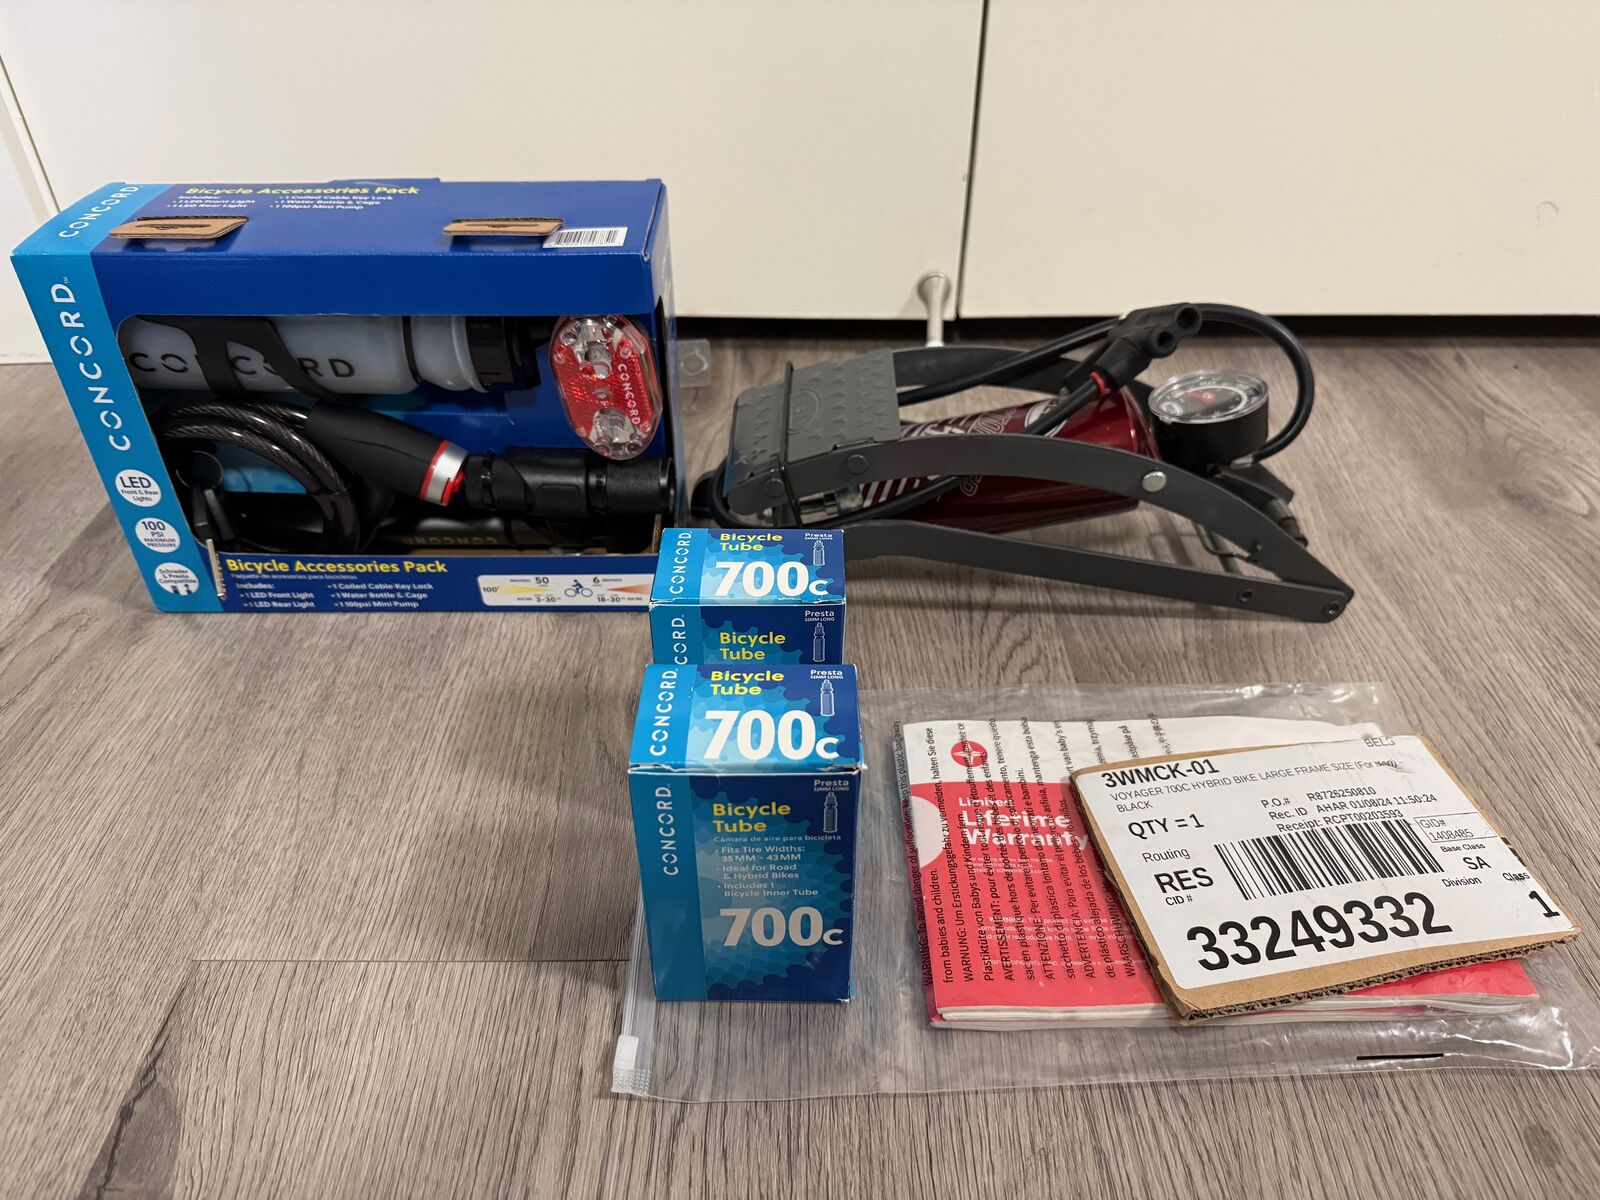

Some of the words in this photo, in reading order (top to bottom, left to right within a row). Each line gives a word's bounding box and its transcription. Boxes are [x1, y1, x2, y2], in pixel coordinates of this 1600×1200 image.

[375, 186, 420, 194] Pack
[58, 185, 140, 238] CONCORD
[51, 283, 132, 452] CONCORD
[128, 352, 355, 380] COCRD
[618, 363, 640, 426] CONCORD
[120, 476, 151, 488] LED
[142, 521, 166, 531] 100
[720, 533, 783, 543] Bicycle
[720, 543, 764, 551] Tube
[226, 559, 290, 574] Bicycle
[294, 560, 400, 572] Accessories
[403, 560, 448, 572] Pack
[670, 532, 692, 595] CONCORD
[535, 576, 549, 584] 50
[593, 576, 600, 584] 6
[292, 592, 314, 600] Light
[405, 592, 428, 600] Cage
[672, 615, 689, 665] CORD
[720, 632, 786, 647] Bicycle
[720, 648, 765, 660] Tube
[711, 671, 784, 683] Bicycle
[710, 684, 762, 696] Tube
[650, 670, 678, 756] CONCORD
[925, 727, 935, 744] diese
[989, 718, 1002, 740] questo
[1025, 735, 1034, 750] esta
[1055, 730, 1067, 752] baby's
[896, 752, 908, 774] plastic
[994, 741, 1005, 764] tenere
[930, 757, 940, 779] halten
[979, 752, 992, 778] enfants
[1030, 750, 1044, 786] mantenga
[1101, 758, 1219, 788] 3WMCK-01
[814, 779, 850, 787] Presta
[1015, 768, 1030, 800] bambini.
[1110, 786, 1162, 801] VOYAGER
[1164, 784, 1190, 794] 700C
[1192, 778, 1232, 790] HYBRID
[1234, 774, 1258, 784] BIKE
[1260, 769, 1294, 780] LARGE
[1295, 764, 1331, 775] FRAME
[1331, 762, 1354, 771] SIZE
[1355, 760, 1374, 770] (For
[934, 780, 947, 822] vermeiden,
[1039, 787, 1051, 813] asfixia,
[1116, 800, 1153, 813] BLACK
[1261, 797, 1290, 808] P.O.#
[1307, 786, 1376, 802] R8726250810
[1269, 809, 1294, 820] Rec.
[1298, 807, 1308, 816] ID
[1316, 802, 1348, 814] AHAR
[1350, 799, 1392, 810] 01/08/24
[1393, 794, 1437, 805] 11:50:24
[712, 802, 791, 819] Bicycle
[962, 811, 1069, 828] Lifetime
[1276, 820, 1322, 833] Receipt:
[1323, 809, 1403, 825] RCPT00203593
[655, 786, 679, 876] CONCORD
[713, 820, 767, 833] Tube
[1128, 818, 1168, 840] QTY
[1420, 818, 1446, 829] GID#
[714, 835, 747, 843] Cámara
[964, 830, 1088, 850] Warranty
[1428, 829, 1474, 841] 1408485
[721, 846, 740, 854] Fits
[764, 845, 805, 853] Widths:
[960, 830, 972, 863] Kindern
[998, 843, 1010, 869] portée
[1142, 848, 1190, 864] Routing
[1440, 845, 1461, 853] Base
[722, 854, 756, 862] 35MM
[752, 864, 767, 872] for
[983, 853, 993, 876] éviter
[1038, 852, 1052, 884] lontano
[1463, 856, 1491, 870] SA
[734, 872, 769, 880] Hybrid
[942, 834, 961, 908] Erstickungsgefahr
[1059, 863, 1072, 887] evitar
[1154, 867, 1214, 894] RES
[1441, 877, 1482, 887] Division
[1502, 872, 1530, 882] Class
[724, 890, 760, 898] Bicycle
[792, 888, 818, 896] Tube
[930, 868, 941, 905] children.
[988, 878, 1000, 899] pour
[1007, 883, 1018, 902] hors
[1023, 868, 1035, 897] evitare
[969, 882, 982, 909] Babys
[1046, 886, 1063, 920] plastica
[1065, 888, 1077, 908] Para
[1166, 895, 1185, 906] CID
[1187, 894, 1193, 902] #
[1528, 890, 1560, 918] 1
[933, 908, 945, 924] and
[955, 910, 965, 926] Um
[1084, 891, 1100, 925] alejada
[1012, 904, 1030, 947] plastique
[1187, 892, 1453, 971] 33249332
[938, 926, 950, 957] babies
[991, 900, 1015, 980] AVERTISSEMENT:
[1033, 916, 1055, 980] ATTENZIONE:
[1071, 909, 1096, 979] ADVERTENCIA:
[1096, 926, 1114, 963] plástico
[957, 928, 974, 982] WARNUNG:
[978, 930, 994, 981] Plastiktüte
[1058, 933, 1076, 979] sacchetto
[943, 960, 954, 983] from
